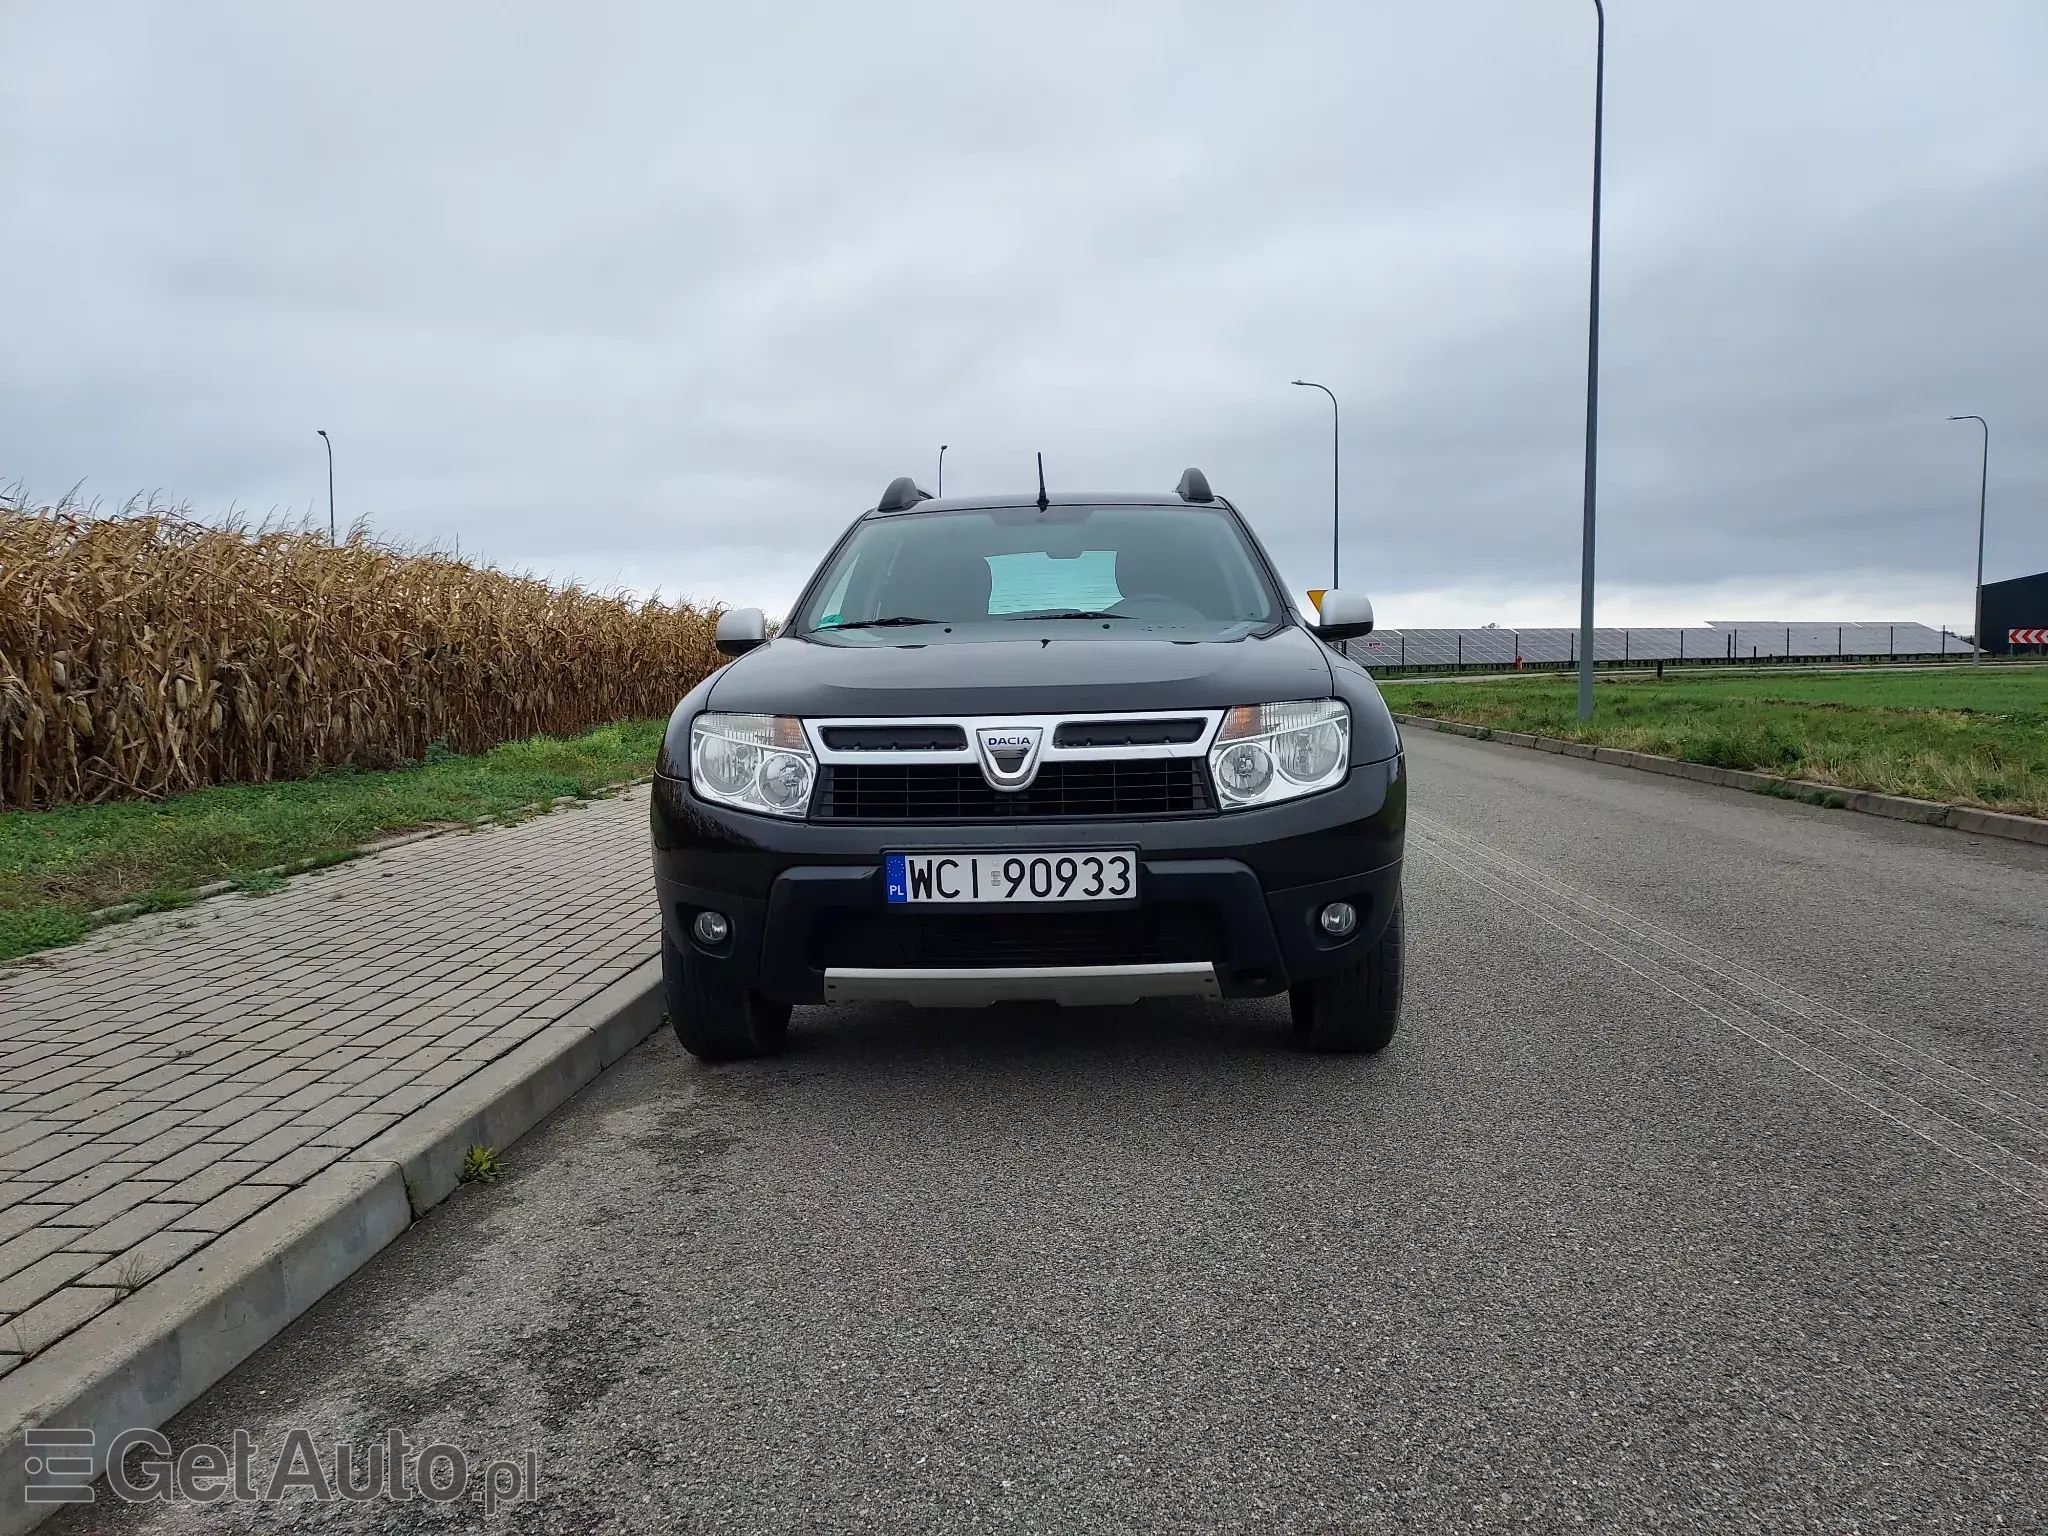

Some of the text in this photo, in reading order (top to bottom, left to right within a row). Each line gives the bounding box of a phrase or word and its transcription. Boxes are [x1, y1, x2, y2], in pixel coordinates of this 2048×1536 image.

[988, 737, 1031, 745] DACIA
[908, 856, 1131, 899] WCI 90933
[889, 885, 905, 896] PL
